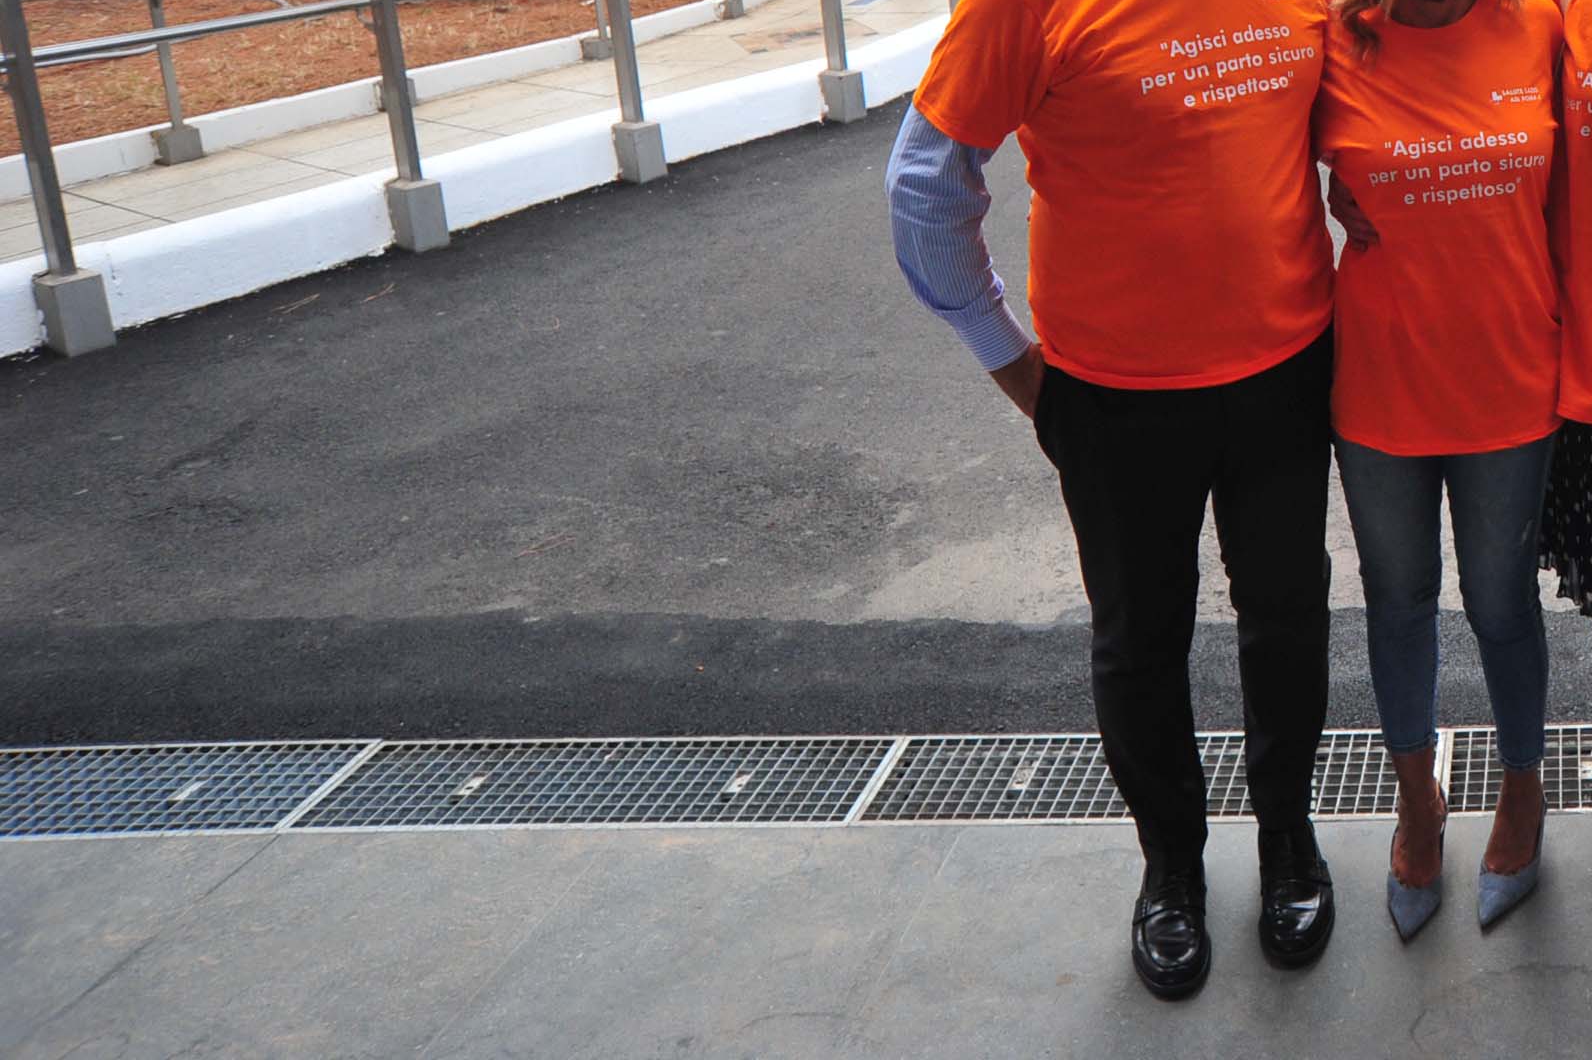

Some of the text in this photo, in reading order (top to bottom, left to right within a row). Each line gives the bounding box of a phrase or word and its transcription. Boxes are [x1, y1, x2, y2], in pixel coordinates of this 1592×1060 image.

[1160, 24, 1290, 58] "Agisci adesso
[1141, 46, 1315, 94] per un parto sicuro
[1184, 70, 1294, 107] e rispettoso"
[1384, 131, 1528, 159] "Agisci adesso
[1580, 126, 1590, 137] e
[1368, 153, 1545, 187] per un parto sicuro
[1404, 177, 1521, 205] e rispettoso"
